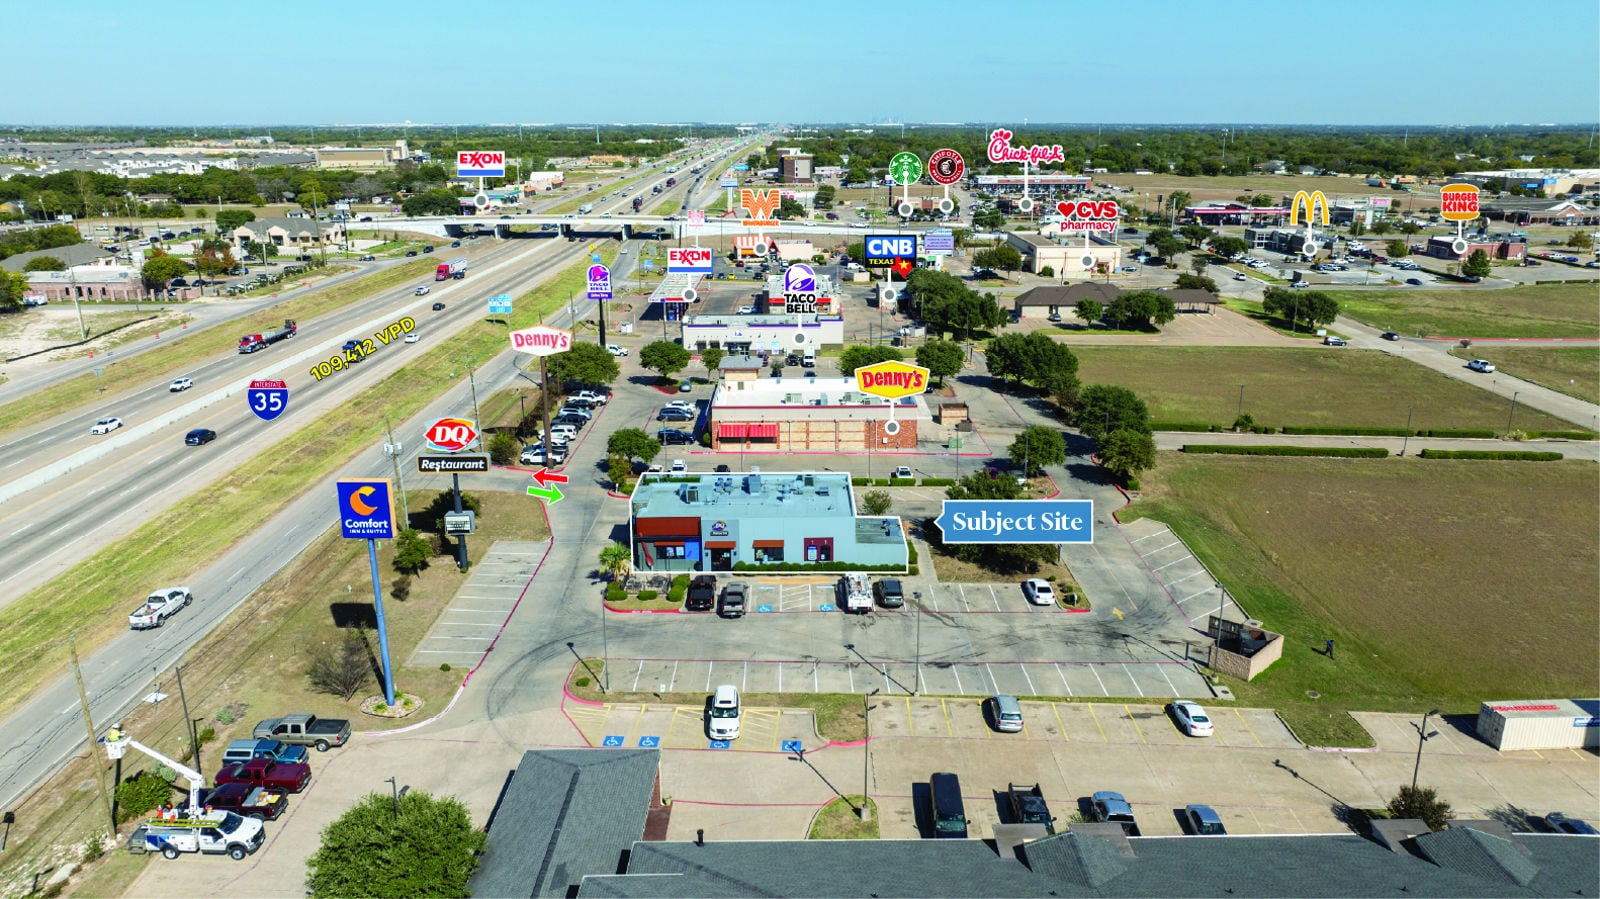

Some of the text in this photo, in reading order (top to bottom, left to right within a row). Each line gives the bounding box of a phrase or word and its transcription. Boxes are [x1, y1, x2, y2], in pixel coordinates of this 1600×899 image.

[513, 332, 568, 349] Denny's
[433, 425, 469, 445] DQ
[421, 459, 485, 469] Restaurant
[344, 518, 389, 529] Comfort
